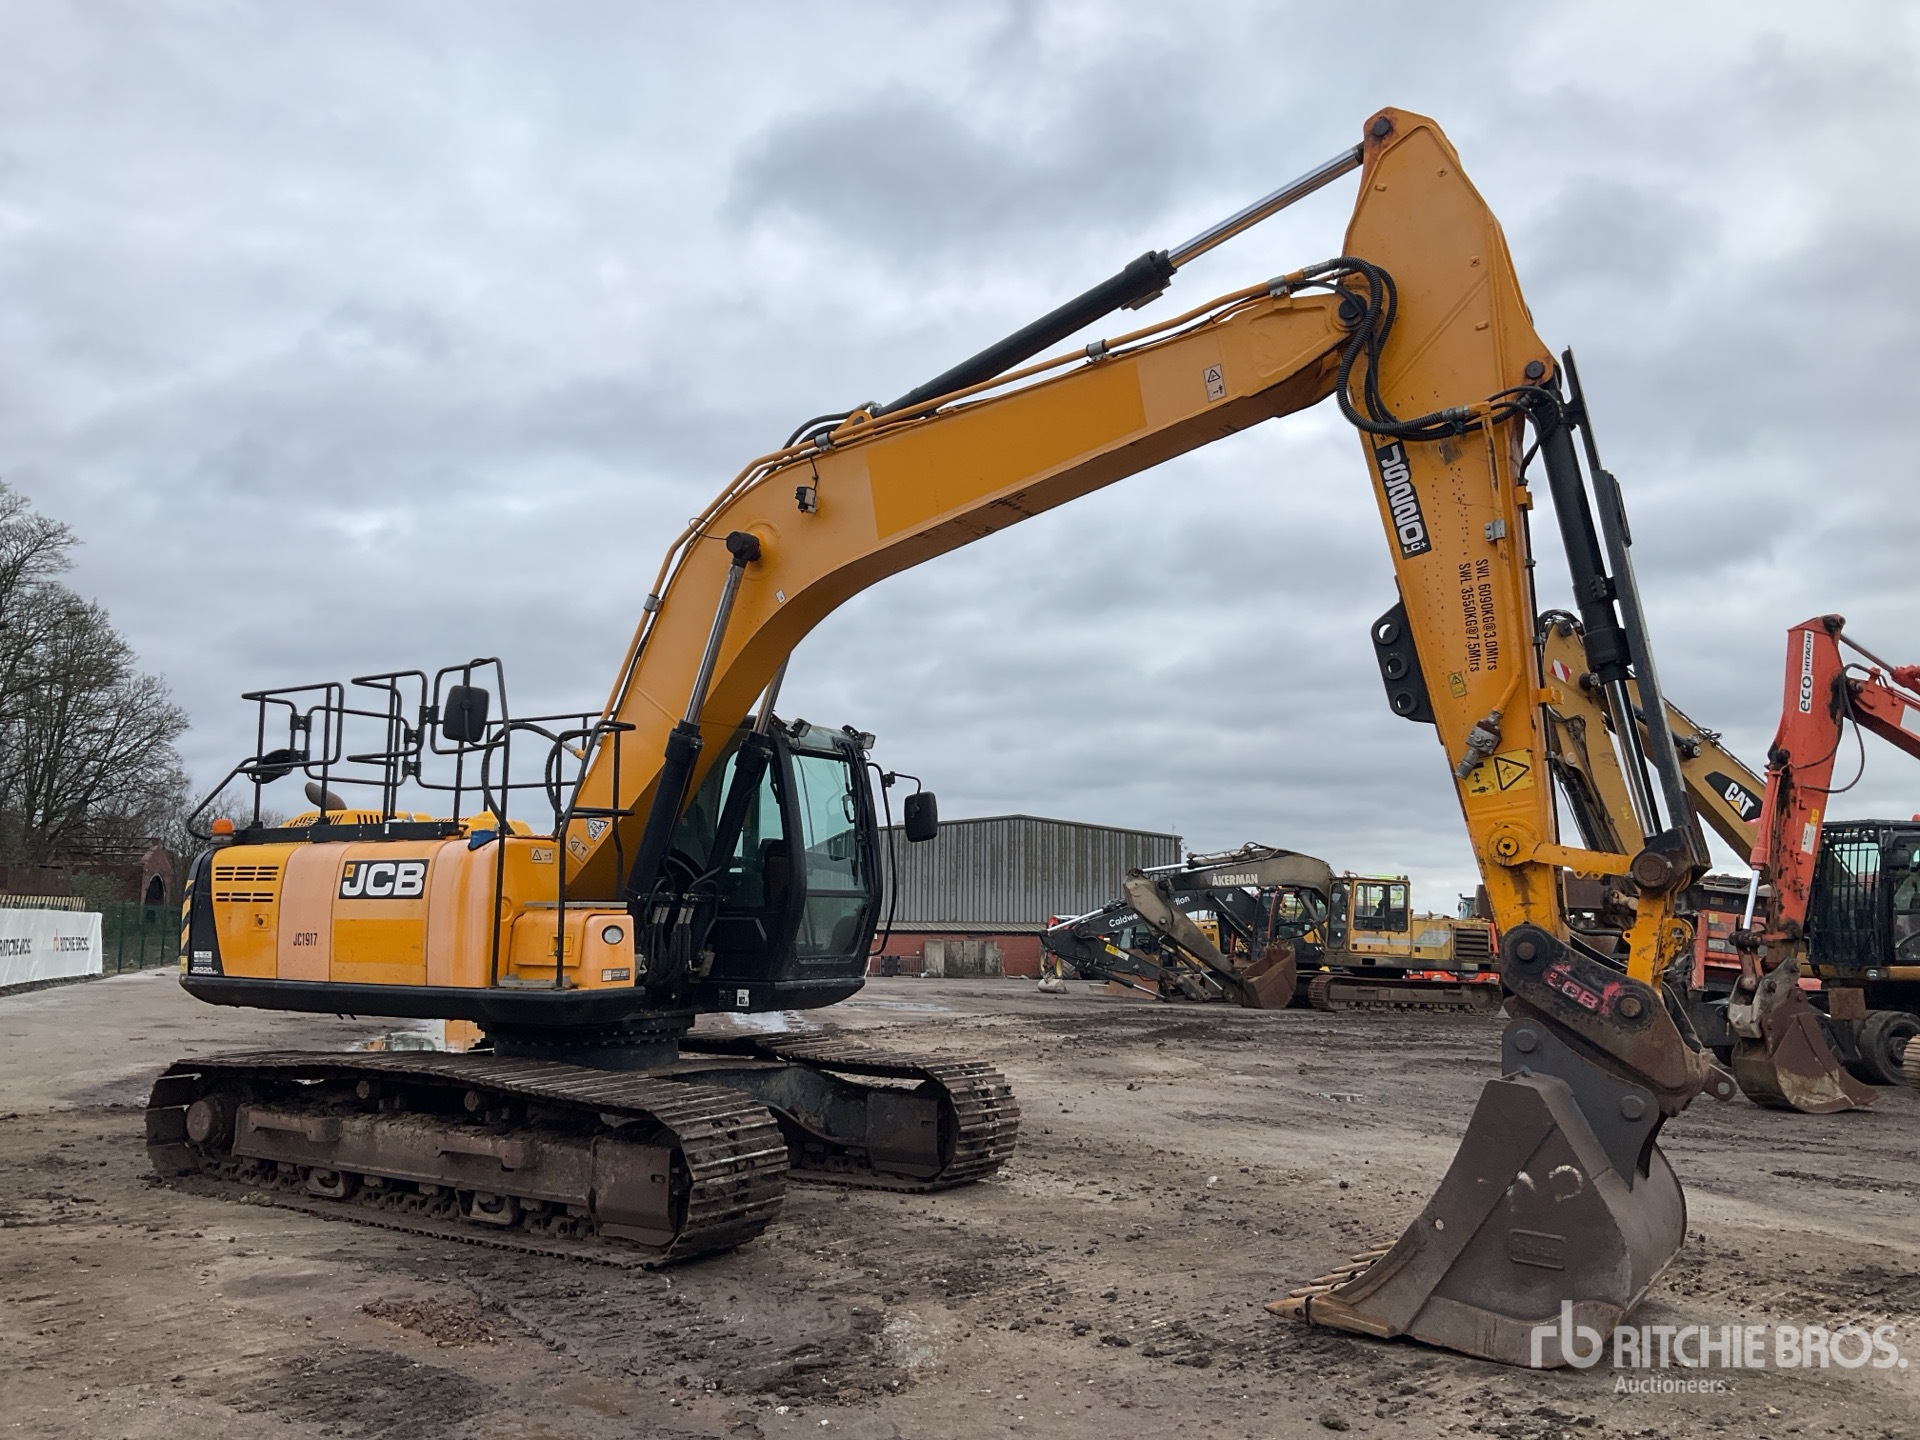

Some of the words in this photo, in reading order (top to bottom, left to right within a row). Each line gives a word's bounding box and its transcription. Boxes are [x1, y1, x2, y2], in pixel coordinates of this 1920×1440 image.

[1381, 444, 1424, 545] JS220
[1404, 541, 1427, 553] LC+
[1459, 563, 1472, 584] SWL
[1476, 559, 1490, 581] SWL
[1478, 583, 1498, 671] 6090KG@3.0Mtrs
[1804, 633, 1812, 671] HITACHI
[1800, 675, 1812, 712] eco
[1724, 782, 1755, 817] CAT
[342, 863, 425, 896] JCB
[1109, 913, 1139, 928] Caldwe
[293, 932, 318, 946] JC1917
